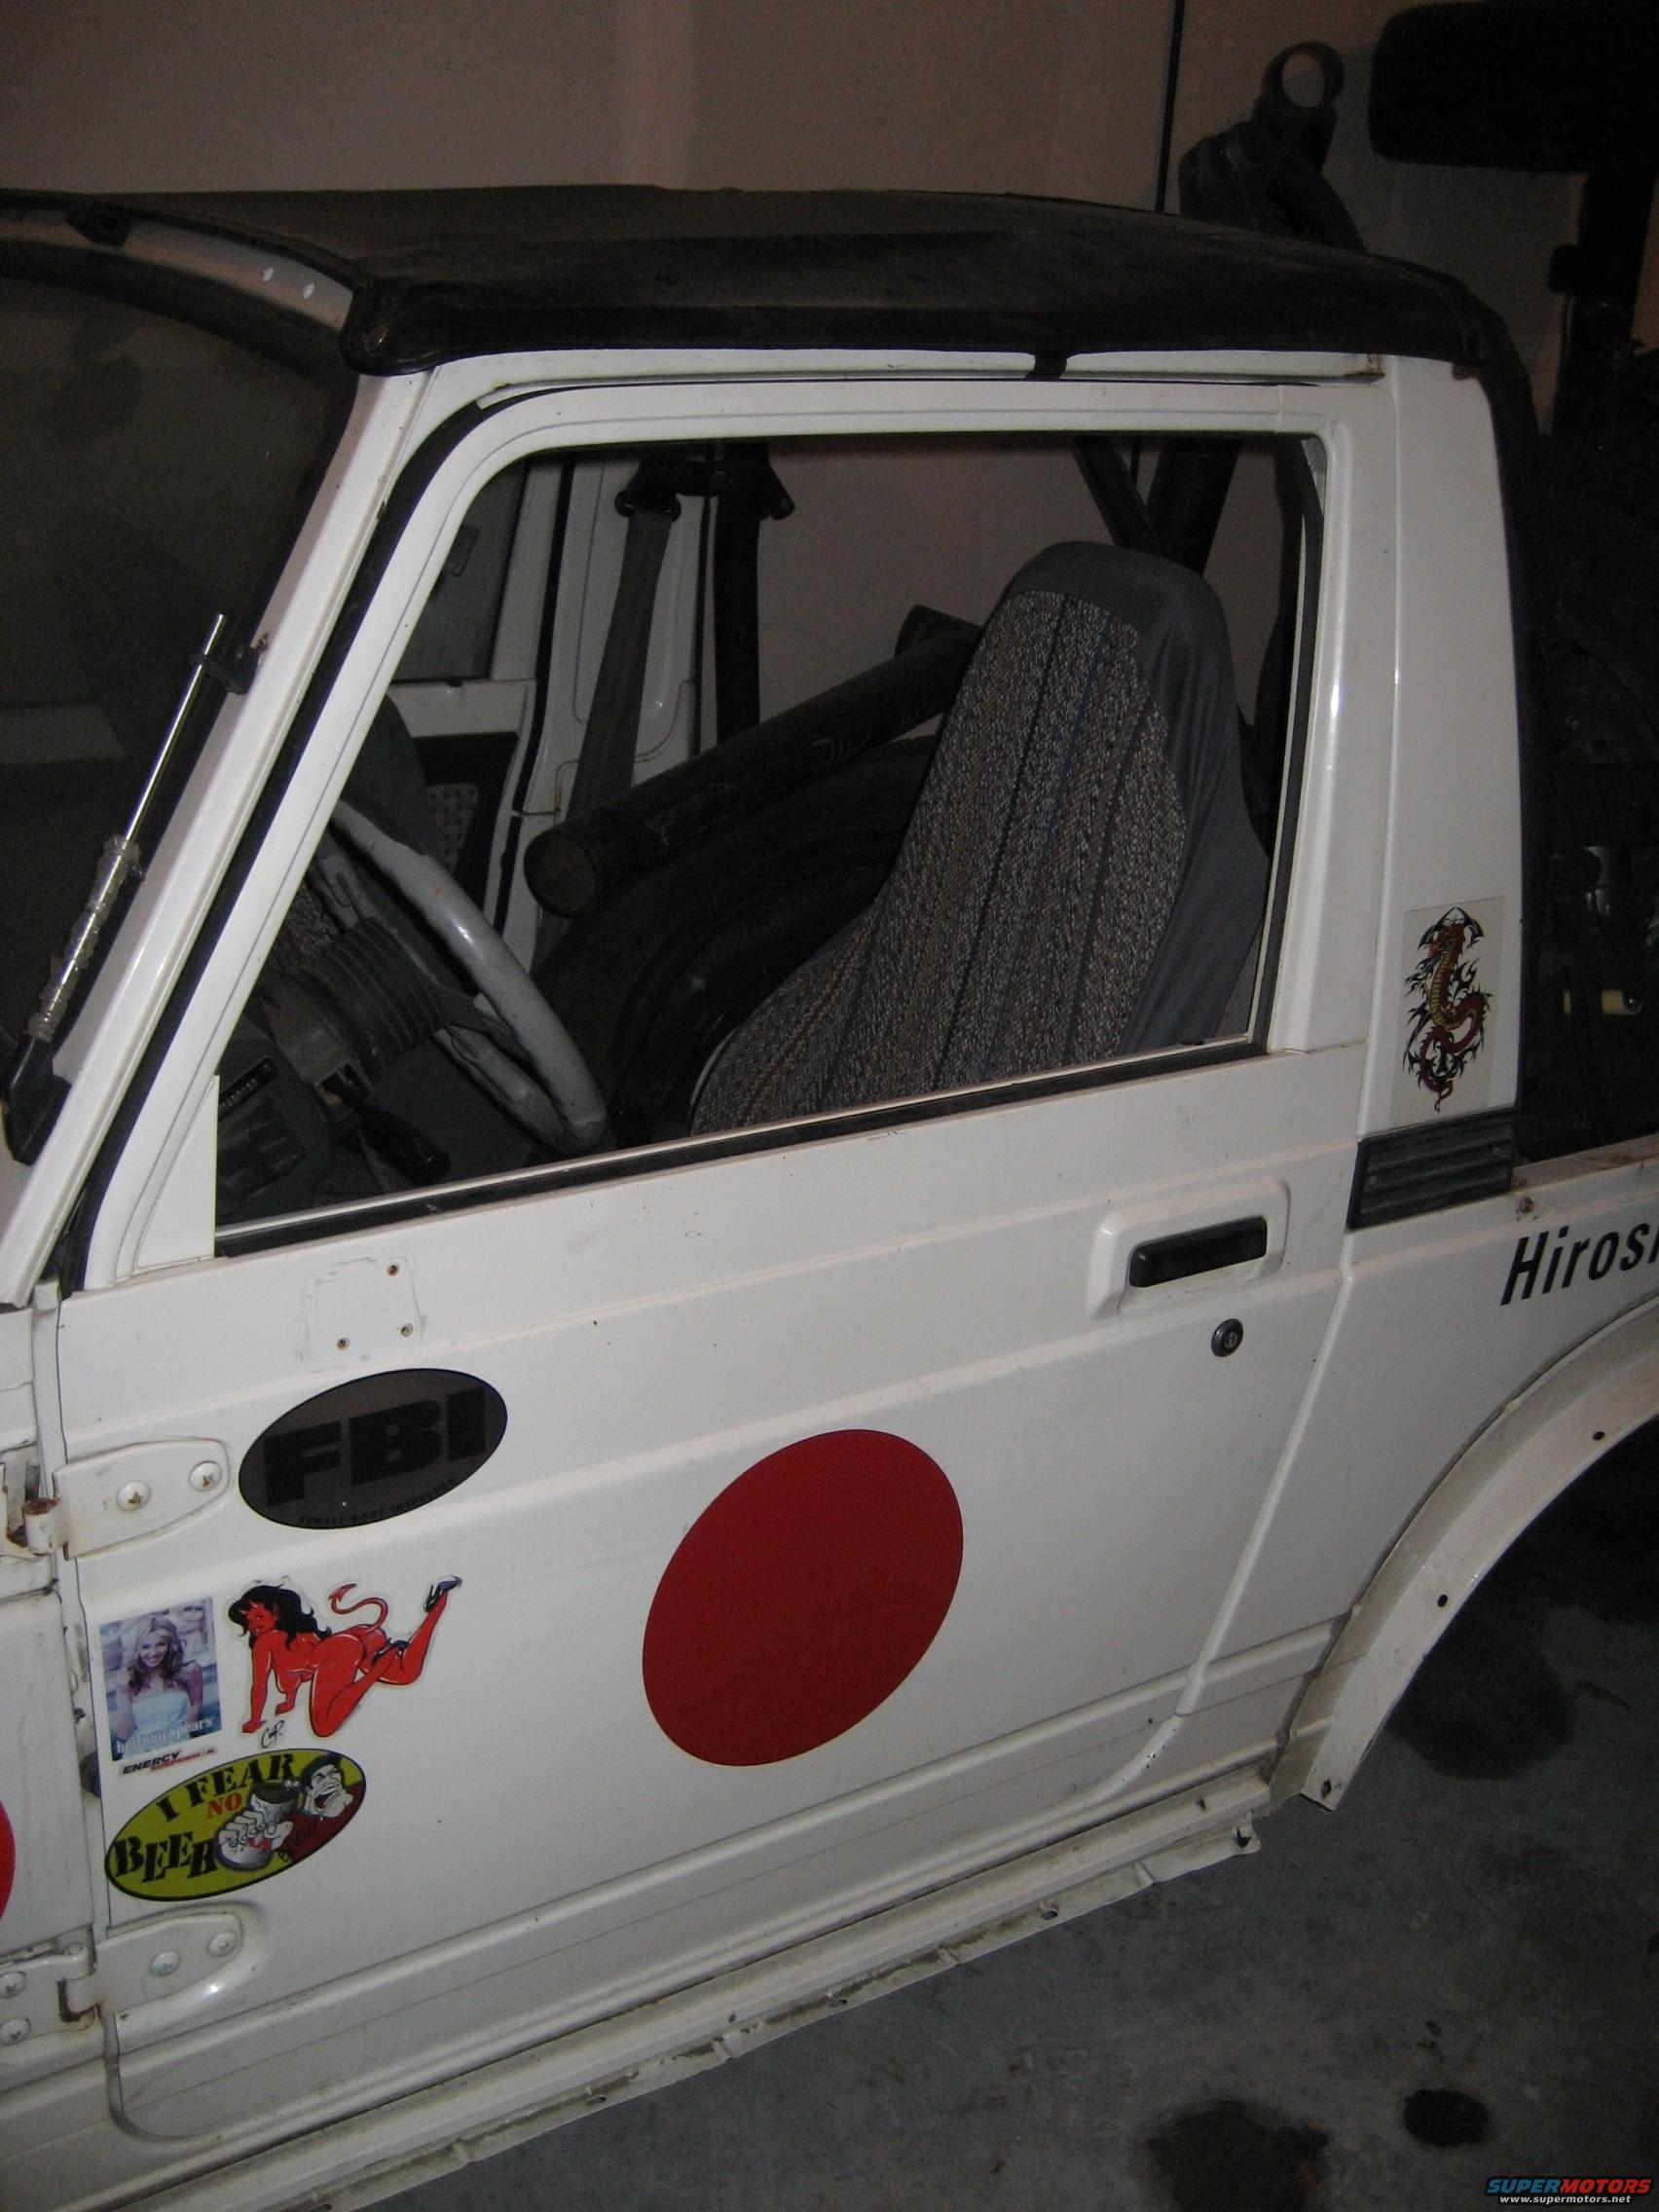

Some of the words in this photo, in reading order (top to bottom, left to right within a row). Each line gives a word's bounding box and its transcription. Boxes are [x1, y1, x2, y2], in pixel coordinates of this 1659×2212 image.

[264, 1386, 485, 1507] FBI
[123, 1751, 181, 1774] ENERGY
[156, 1795, 181, 1823] I
[184, 1752, 296, 1807] FEAR
[205, 1791, 243, 1819] NO
[113, 1832, 218, 1883] BEER
